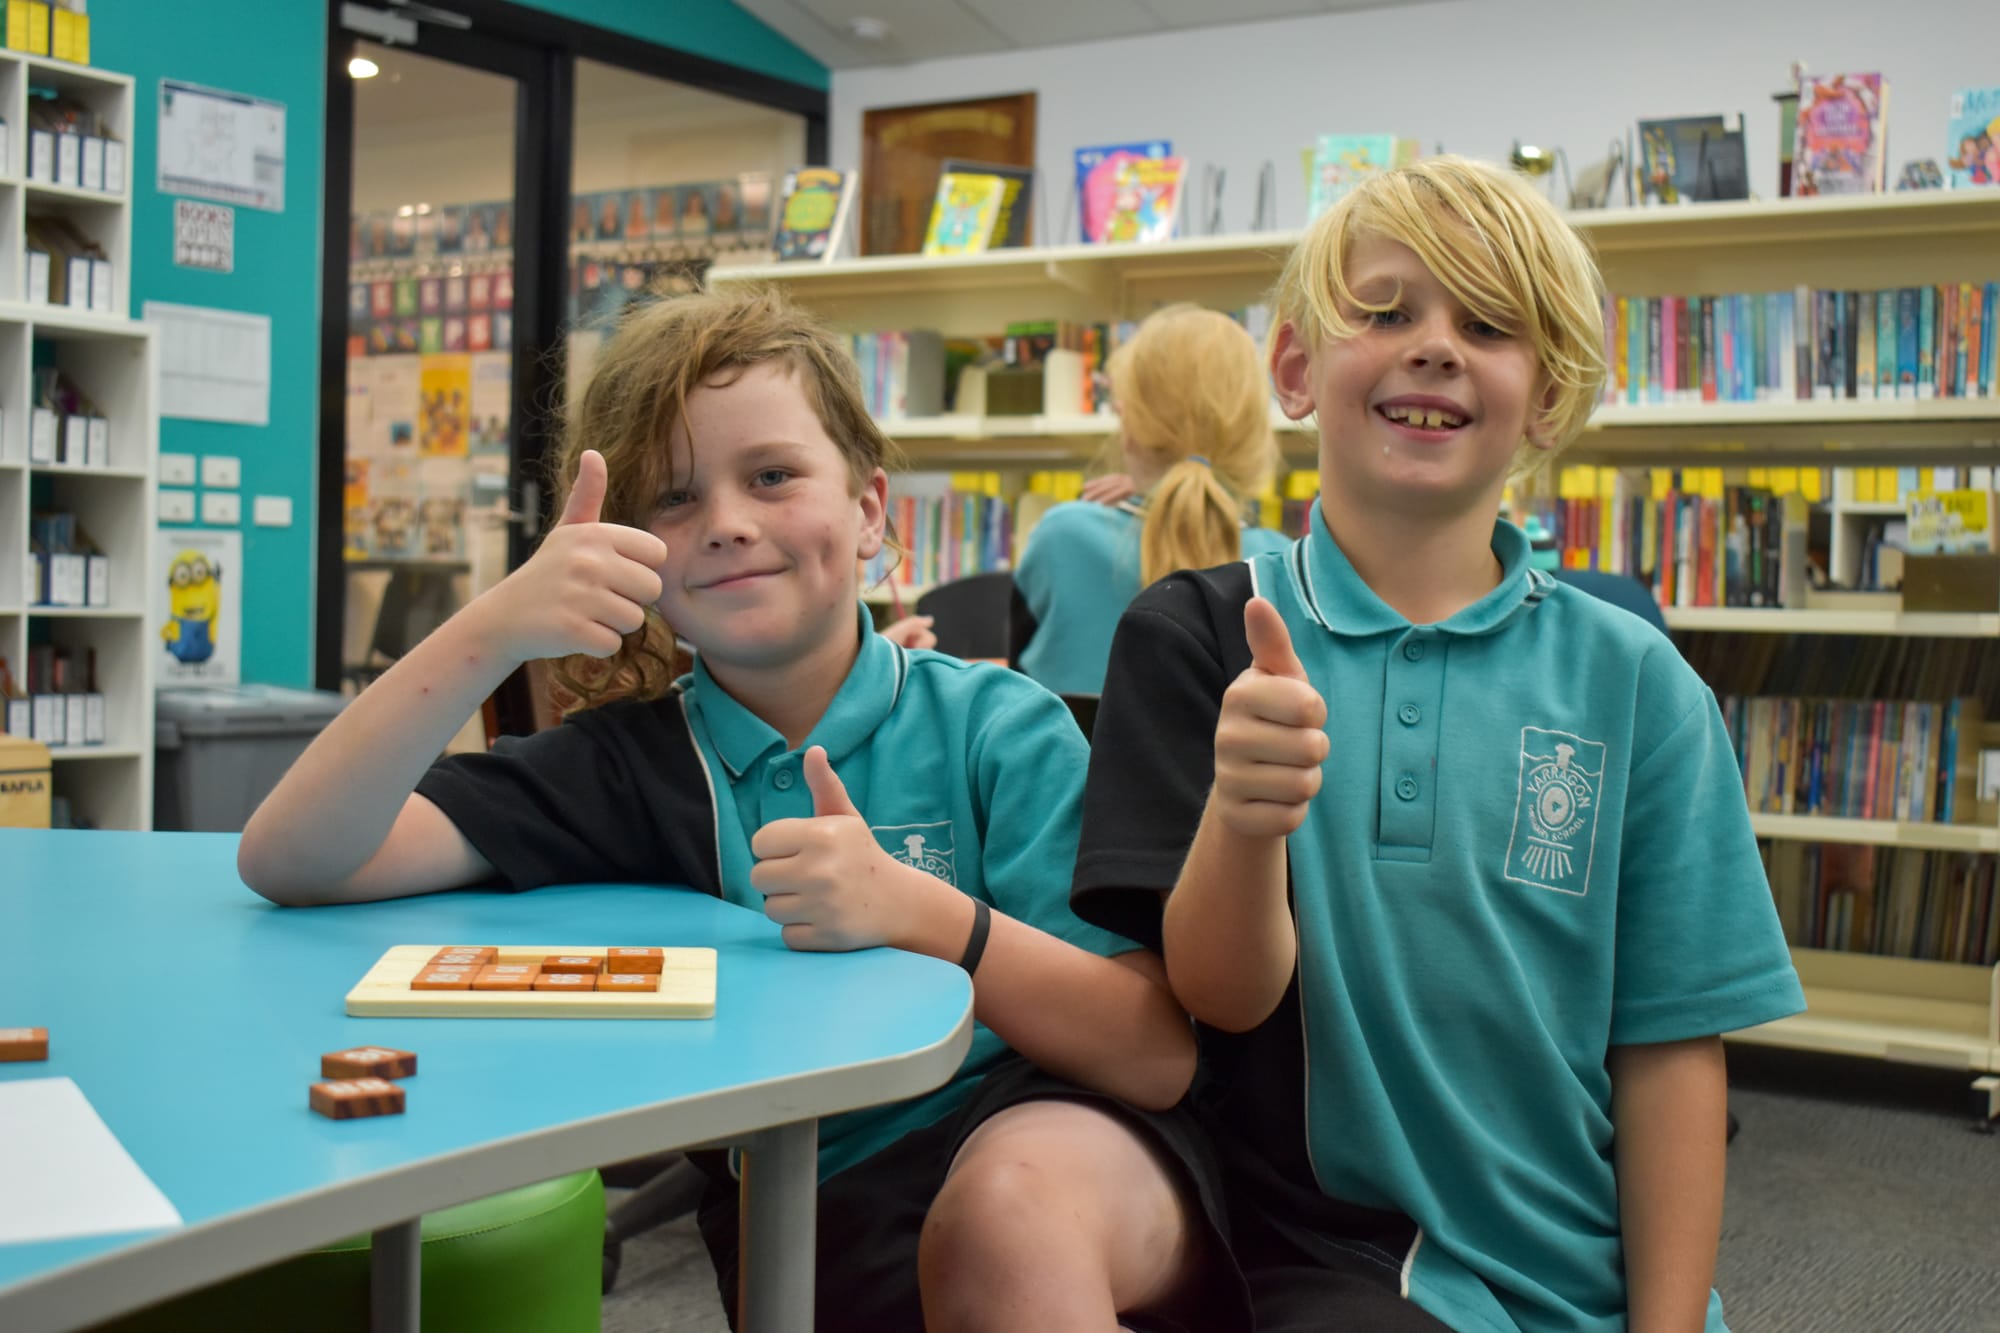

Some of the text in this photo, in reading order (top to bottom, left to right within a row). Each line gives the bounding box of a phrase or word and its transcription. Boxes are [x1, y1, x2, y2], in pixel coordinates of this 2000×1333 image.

[180, 204, 233, 226] BOOKS
[1526, 766, 1591, 808] YARRAGON
[1551, 816, 1586, 842] SCHOOL
